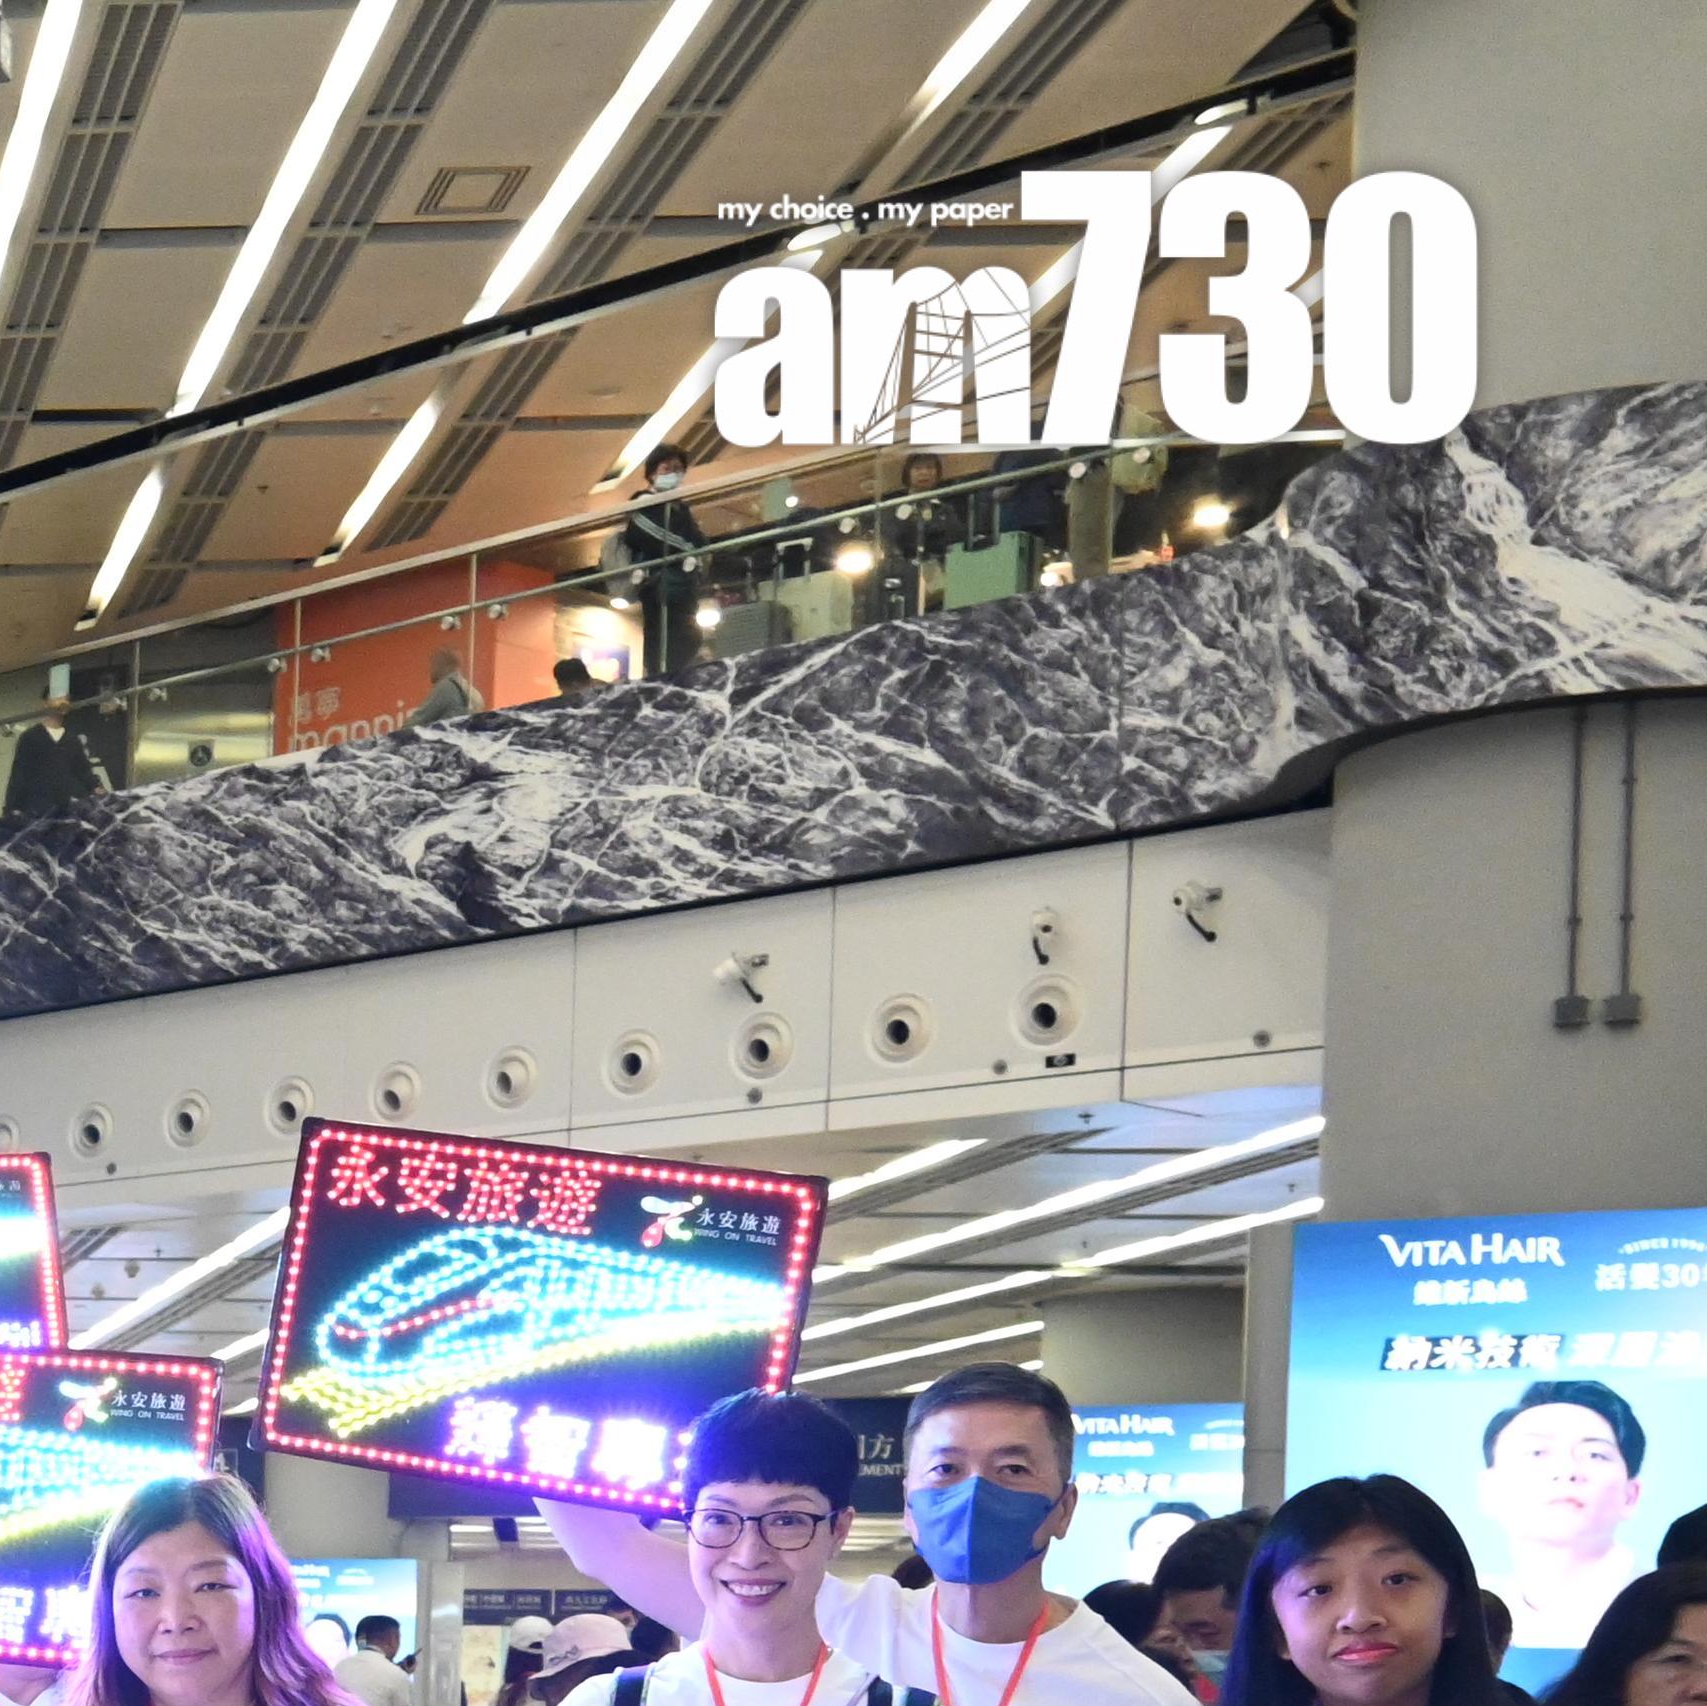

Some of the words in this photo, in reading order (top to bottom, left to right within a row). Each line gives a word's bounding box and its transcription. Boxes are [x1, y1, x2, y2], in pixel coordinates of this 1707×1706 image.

[325, 1143, 604, 1238] 永安旅遊
[696, 1207, 782, 1235] 永安旅遊
[694, 1227, 720, 1239] WING
[724, 1231, 739, 1241] ON
[744, 1233, 778, 1246] TRAVEL
[1378, 1234, 1467, 1268] VITA
[1470, 1232, 1566, 1267] HAIR
[111, 1390, 186, 1411] 永安旅遊
[110, 1408, 134, 1418] WING
[138, 1409, 152, 1419] ON
[156, 1410, 185, 1422] TRAVEL
